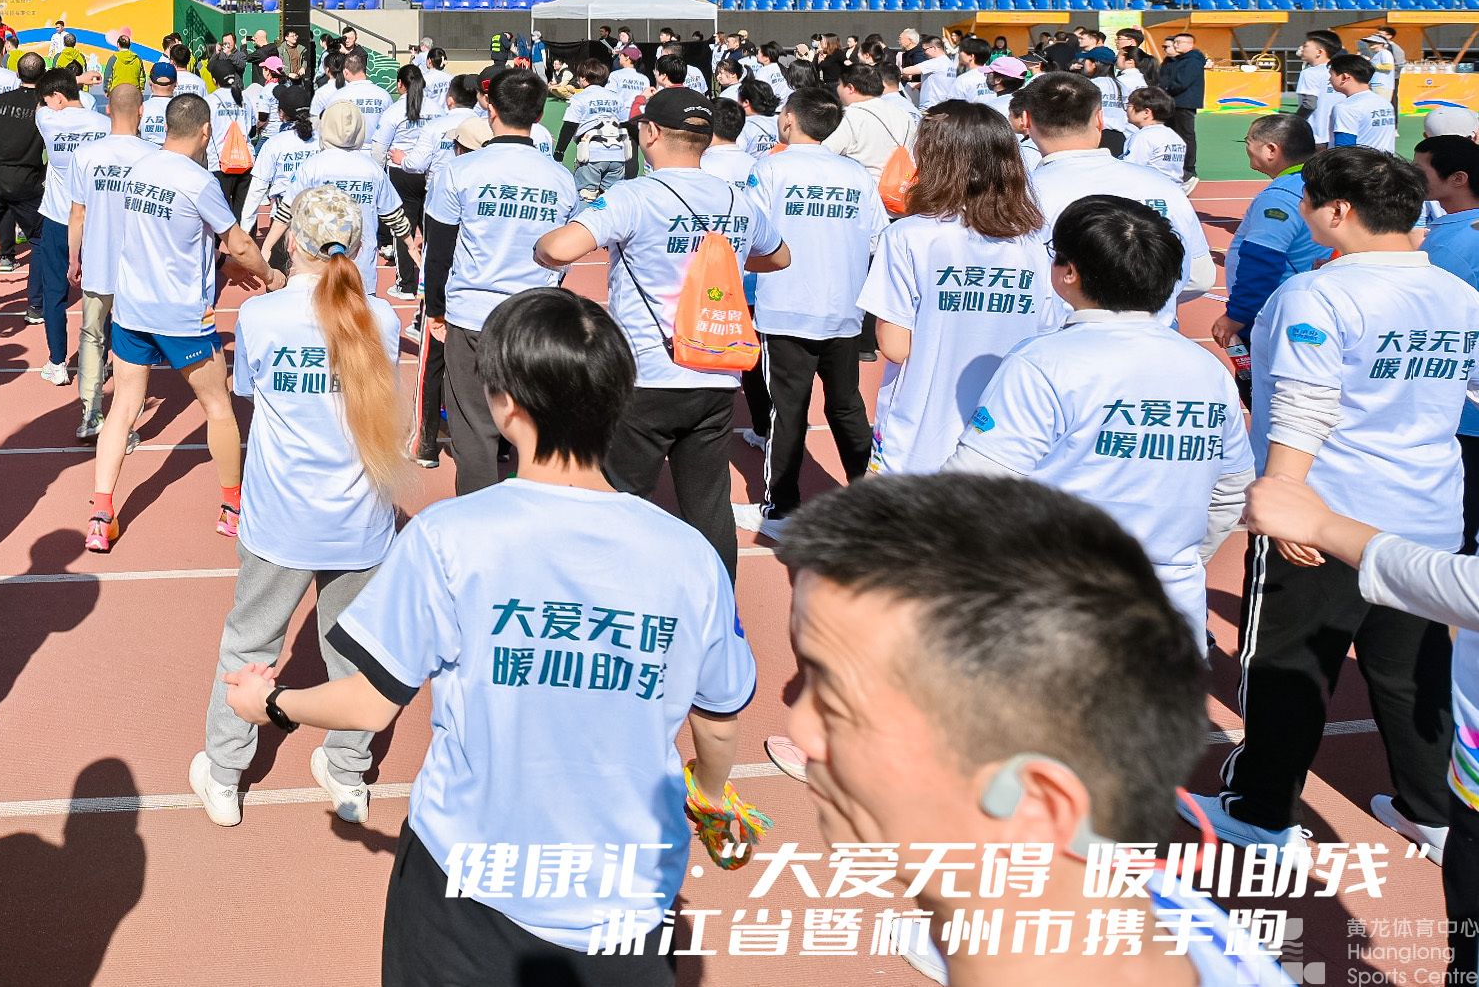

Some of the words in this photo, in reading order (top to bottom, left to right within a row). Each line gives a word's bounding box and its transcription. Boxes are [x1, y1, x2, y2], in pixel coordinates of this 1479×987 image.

[124, 181, 176, 205] 大爱无碍
[478, 183, 558, 206] 大爱无碍
[785, 184, 862, 204] 大爱无碍
[477, 201, 558, 223] 暖心助残
[785, 201, 859, 220] 暖心助残
[668, 214, 749, 233] 大爱无碍
[272, 346, 327, 368] 大爱
[491, 598, 678, 654] 大爱无碍
